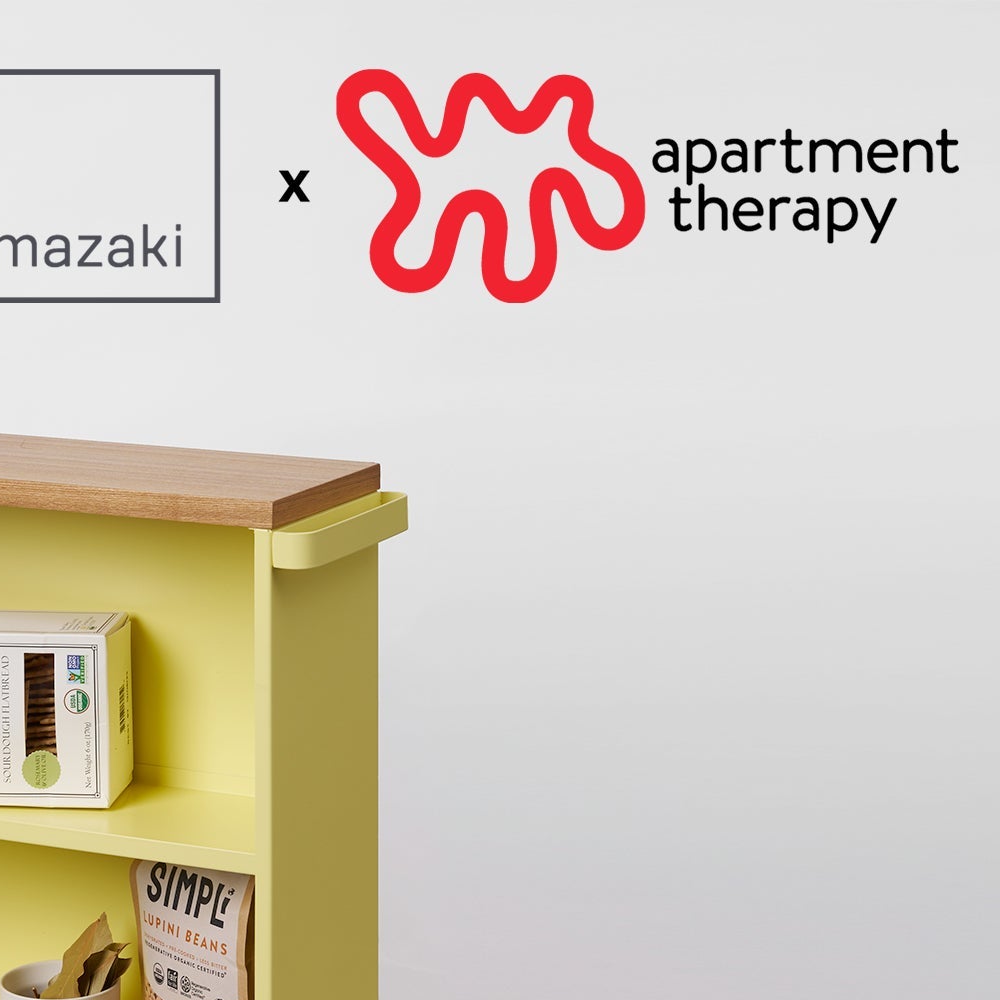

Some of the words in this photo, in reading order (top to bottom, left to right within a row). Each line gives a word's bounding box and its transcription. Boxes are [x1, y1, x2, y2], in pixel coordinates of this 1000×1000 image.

[1, 655, 10, 714] FLATBREAD
[2, 716, 11, 784] SOURDOUGH
[143, 910, 181, 939] LUPINI
[185, 929, 228, 956] BEANS
